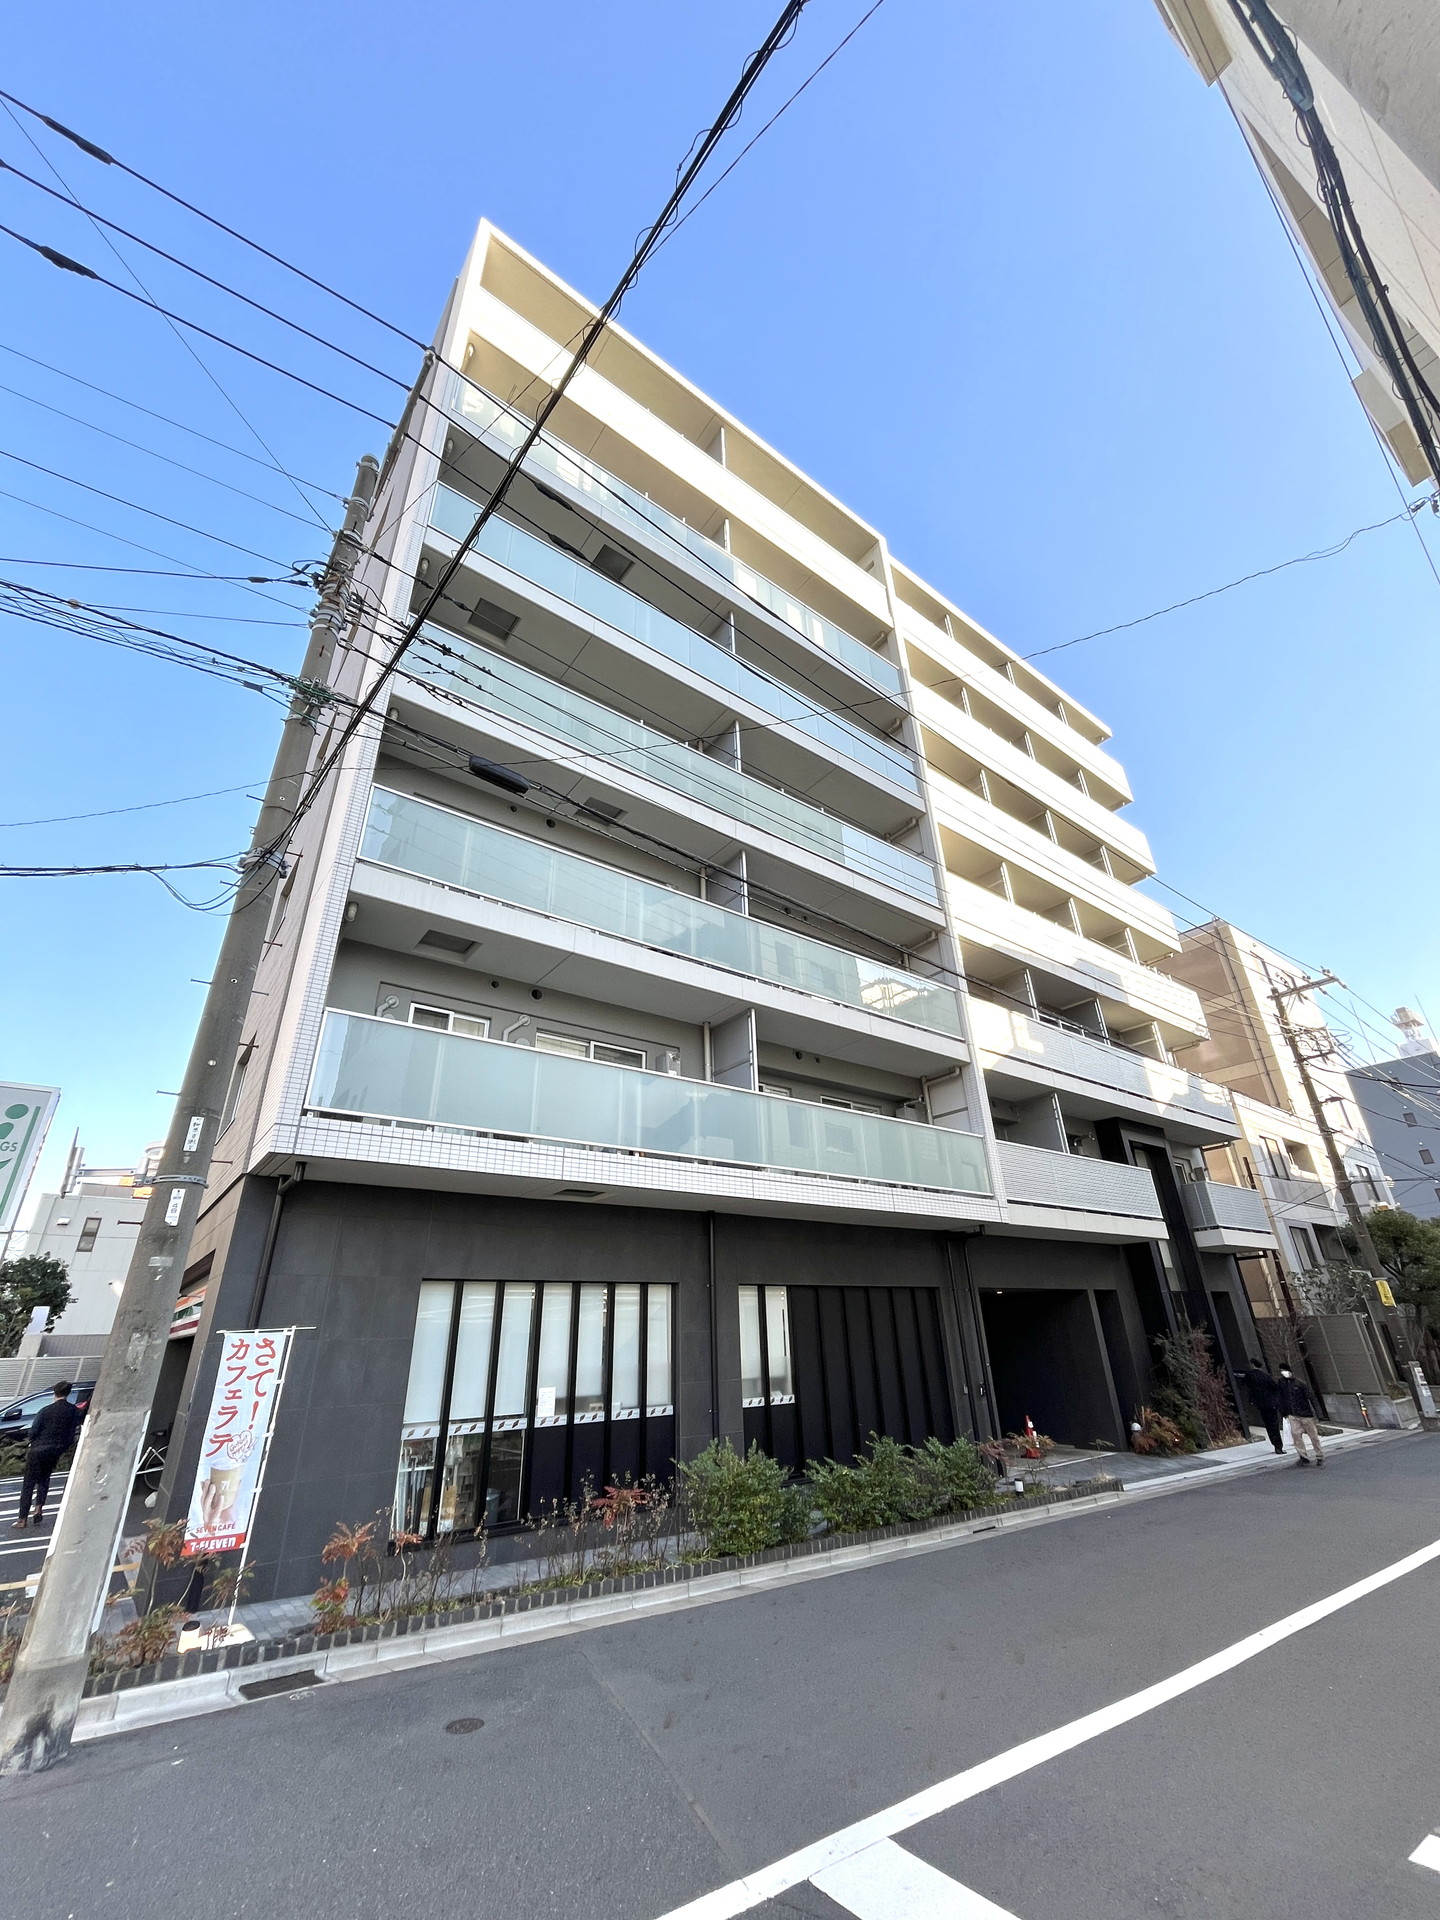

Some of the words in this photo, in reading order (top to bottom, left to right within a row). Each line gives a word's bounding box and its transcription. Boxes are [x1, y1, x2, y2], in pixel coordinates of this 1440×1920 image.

[0, 1141, 18, 1152] GS
[205, 1338, 250, 1457] カフェラテ
[196, 1525, 217, 1534] SEVEN
